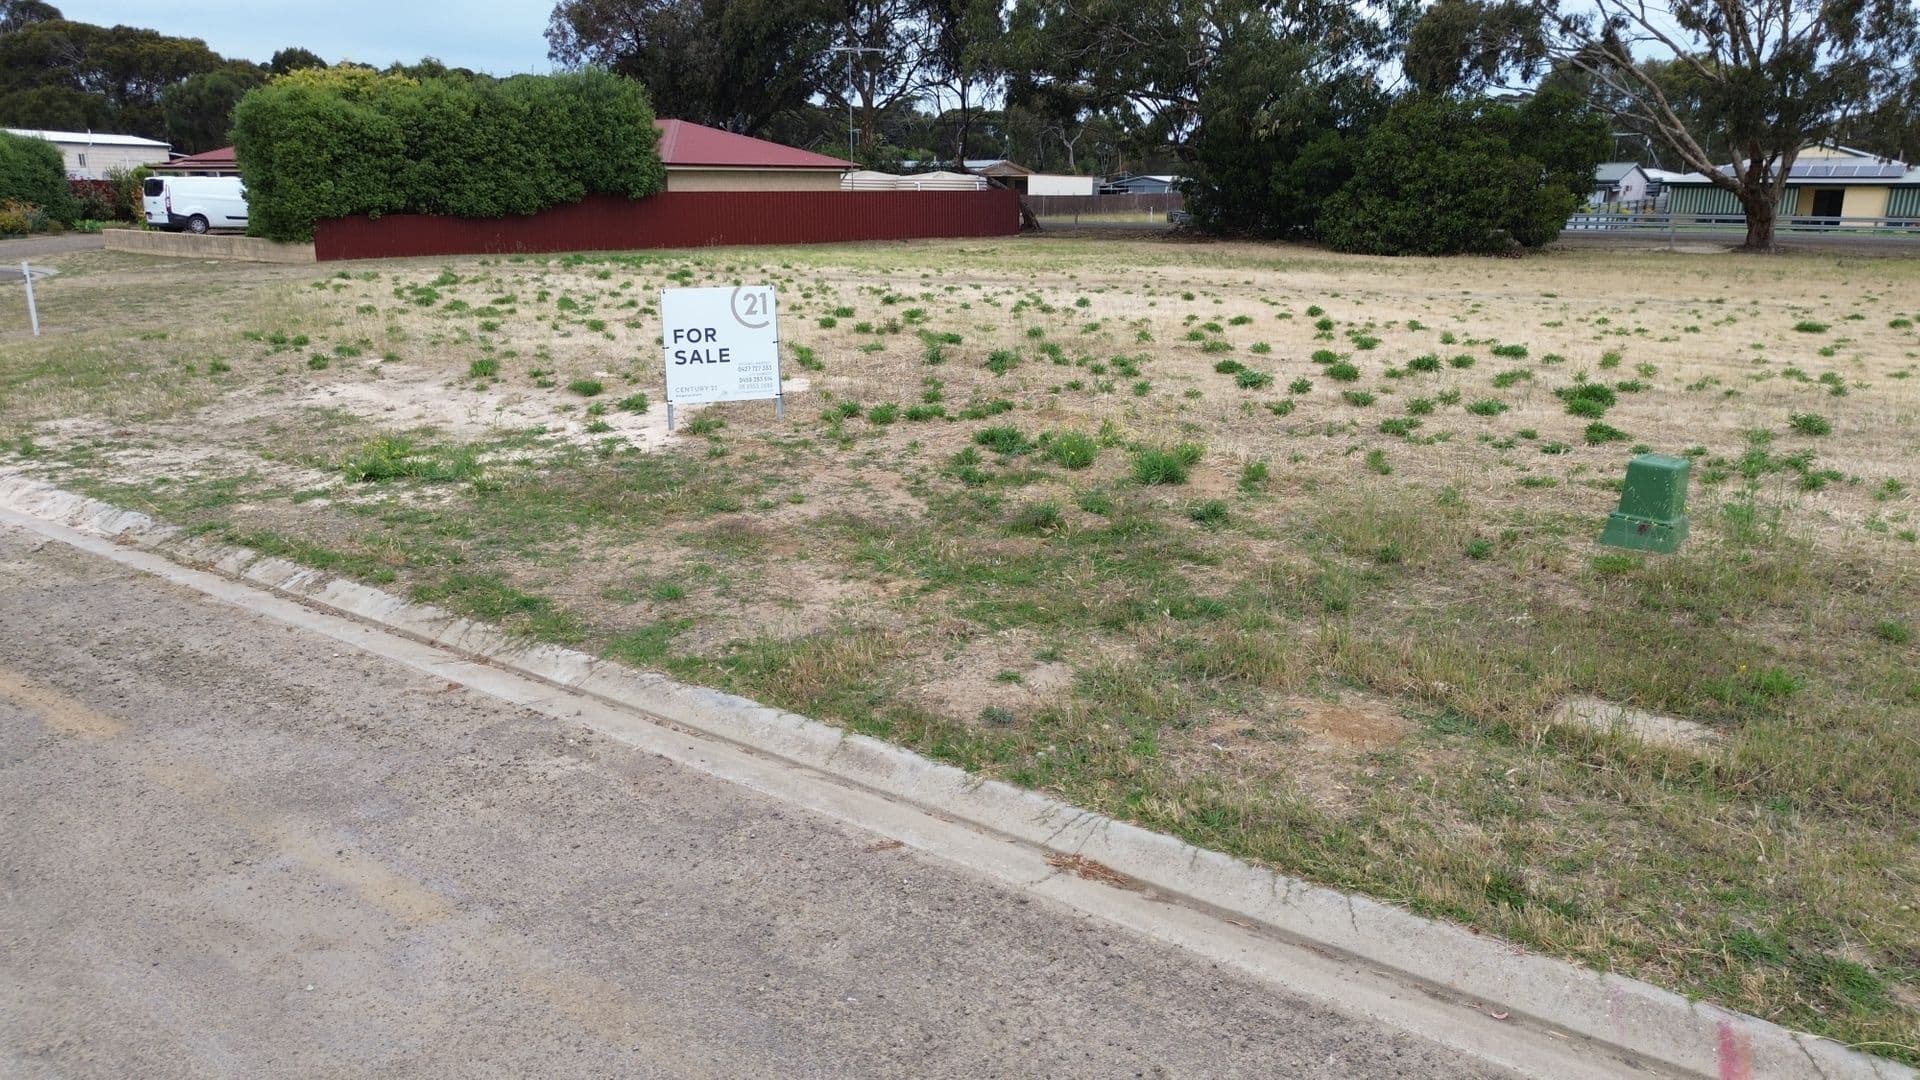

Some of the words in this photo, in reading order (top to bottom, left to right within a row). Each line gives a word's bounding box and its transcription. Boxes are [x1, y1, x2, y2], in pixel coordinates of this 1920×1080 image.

[743, 293, 768, 315] 21
[673, 328, 717, 344] FOR
[674, 348, 731, 365] SALE
[674, 385, 709, 393] CENTURY
